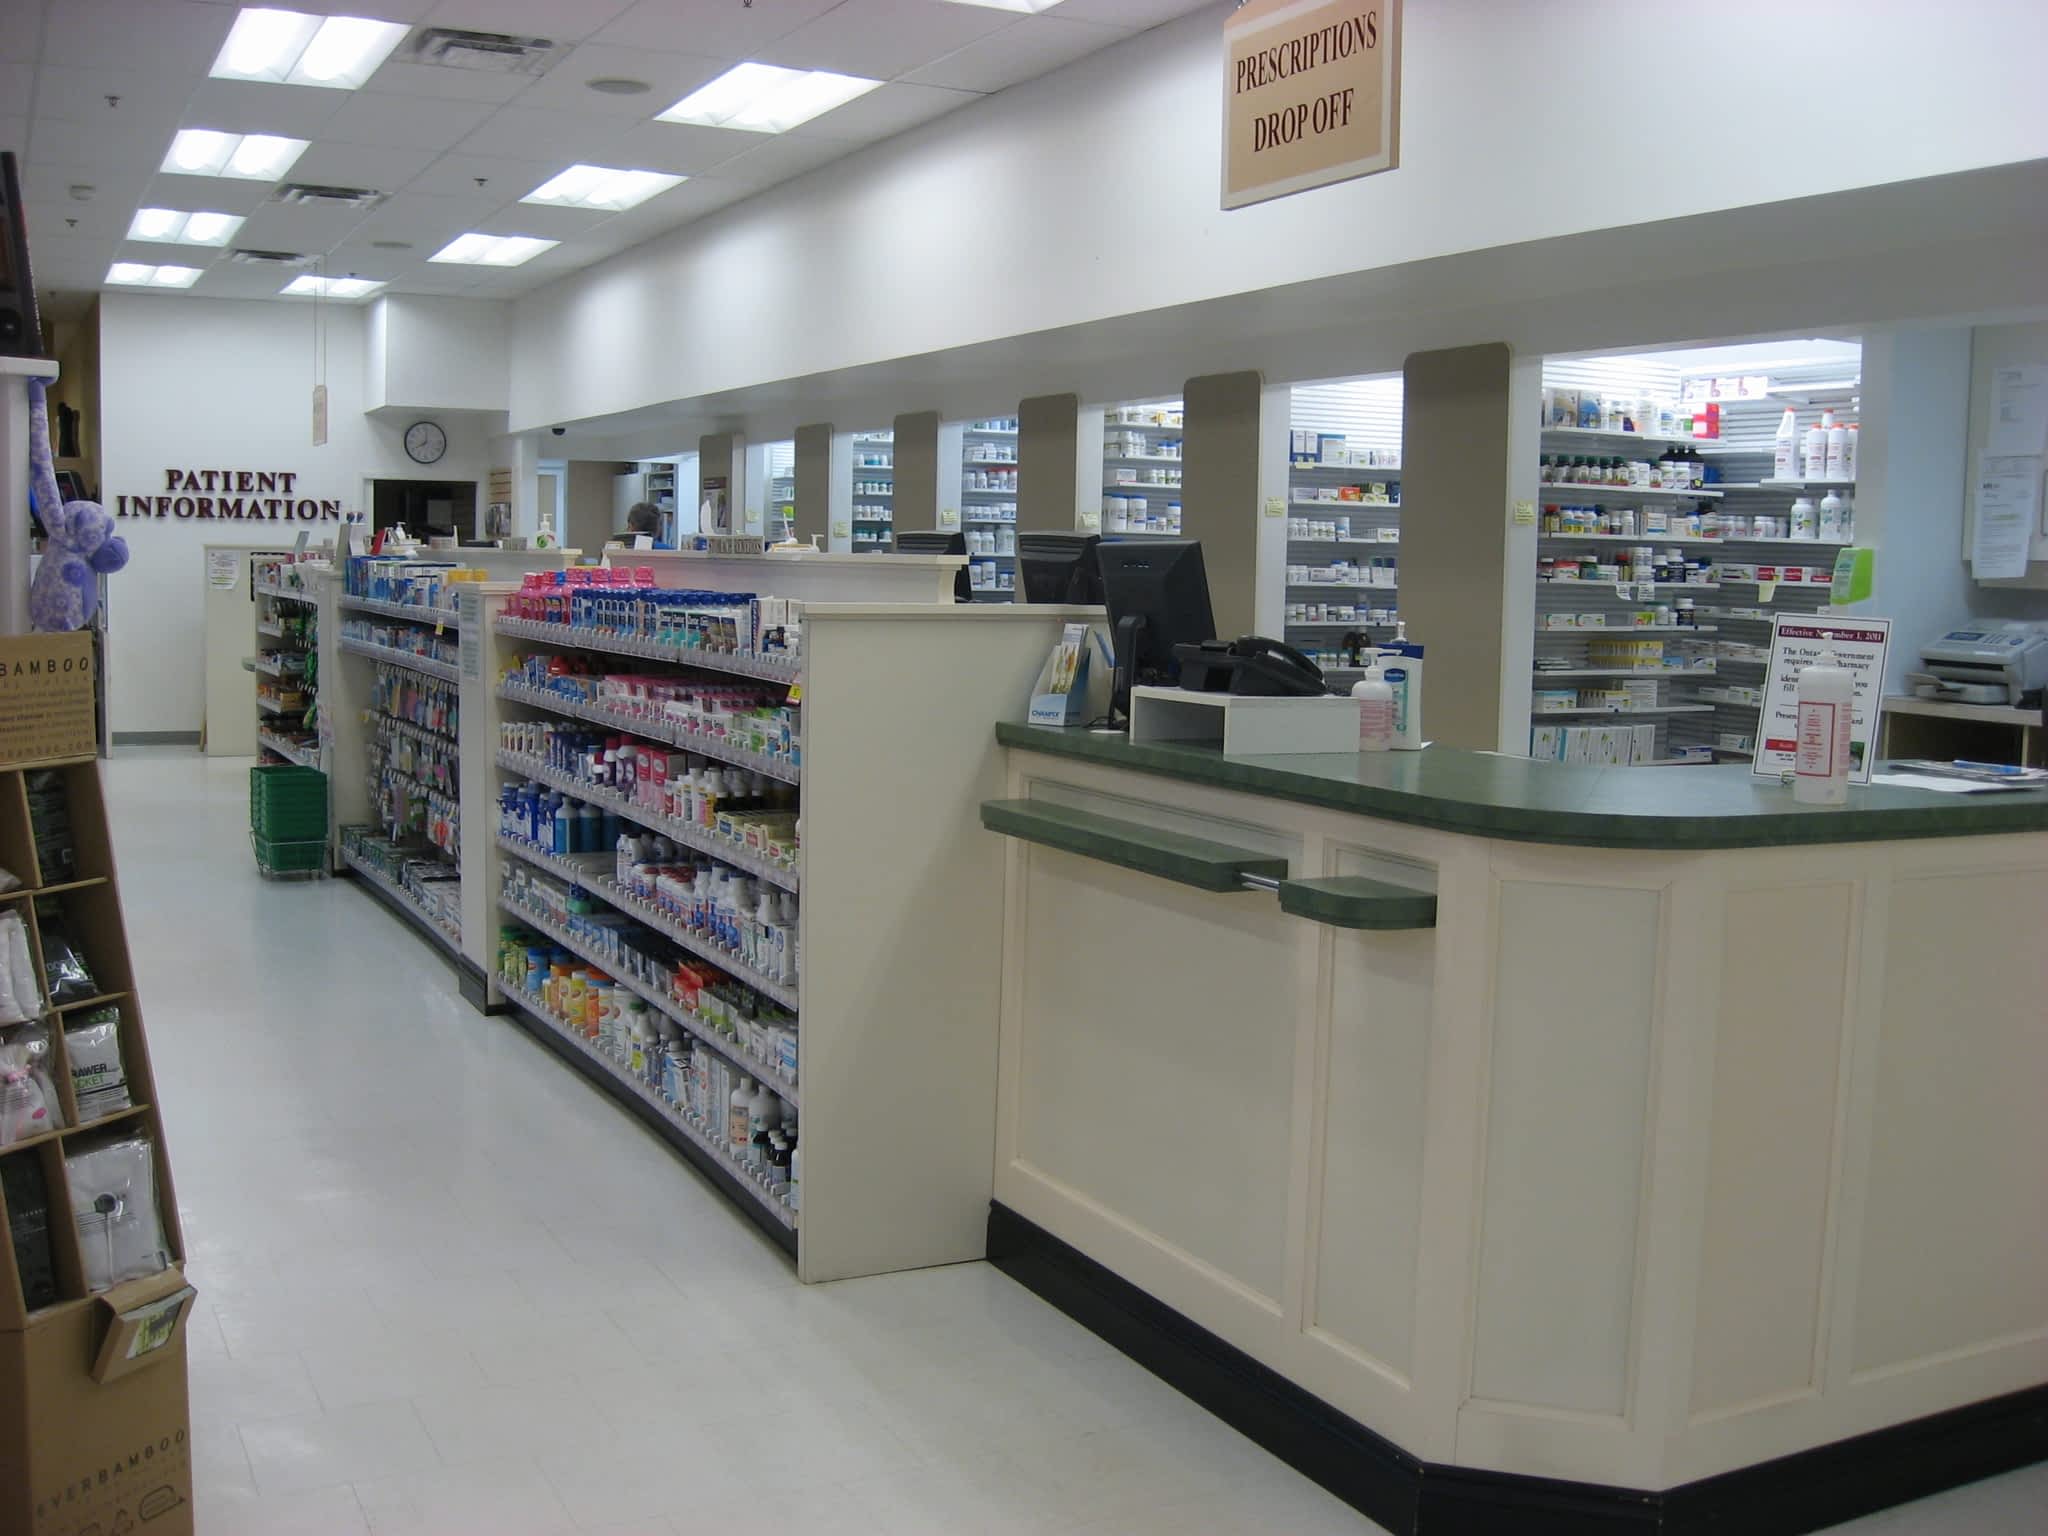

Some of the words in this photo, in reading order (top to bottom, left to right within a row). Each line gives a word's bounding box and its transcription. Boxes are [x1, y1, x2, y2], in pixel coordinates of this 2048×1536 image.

[1236, 11, 1377, 94] PRESCRIPTIONS
[1254, 103, 1308, 152] DROP
[1312, 88, 1354, 134] OFF
[165, 469, 297, 493] PATIENT
[116, 495, 341, 521] INFORMATION
[1780, 627, 1814, 637] Effective
[1783, 647, 1797, 655] The
